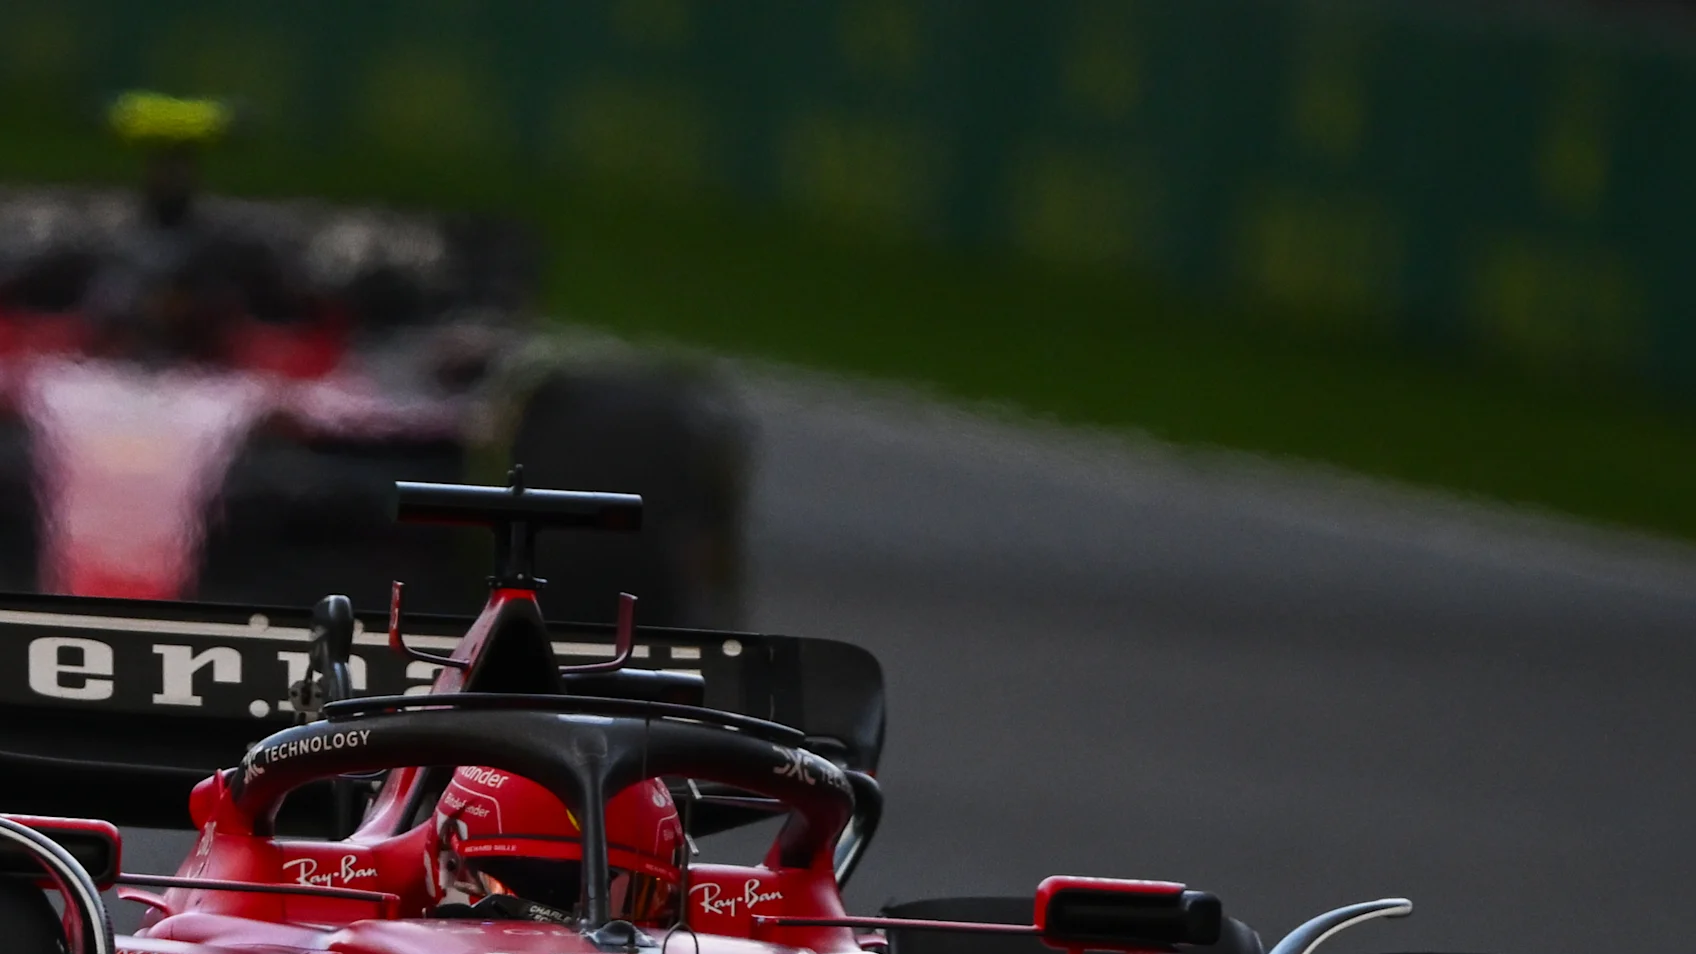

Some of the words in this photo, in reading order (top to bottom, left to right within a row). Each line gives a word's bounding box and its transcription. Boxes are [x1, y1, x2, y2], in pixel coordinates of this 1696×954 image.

[264, 730, 371, 763] TECHNOLOGY
[457, 766, 509, 789] ander
[282, 855, 378, 887] Ray-Ban
[688, 879, 783, 917] Ray-Ban
